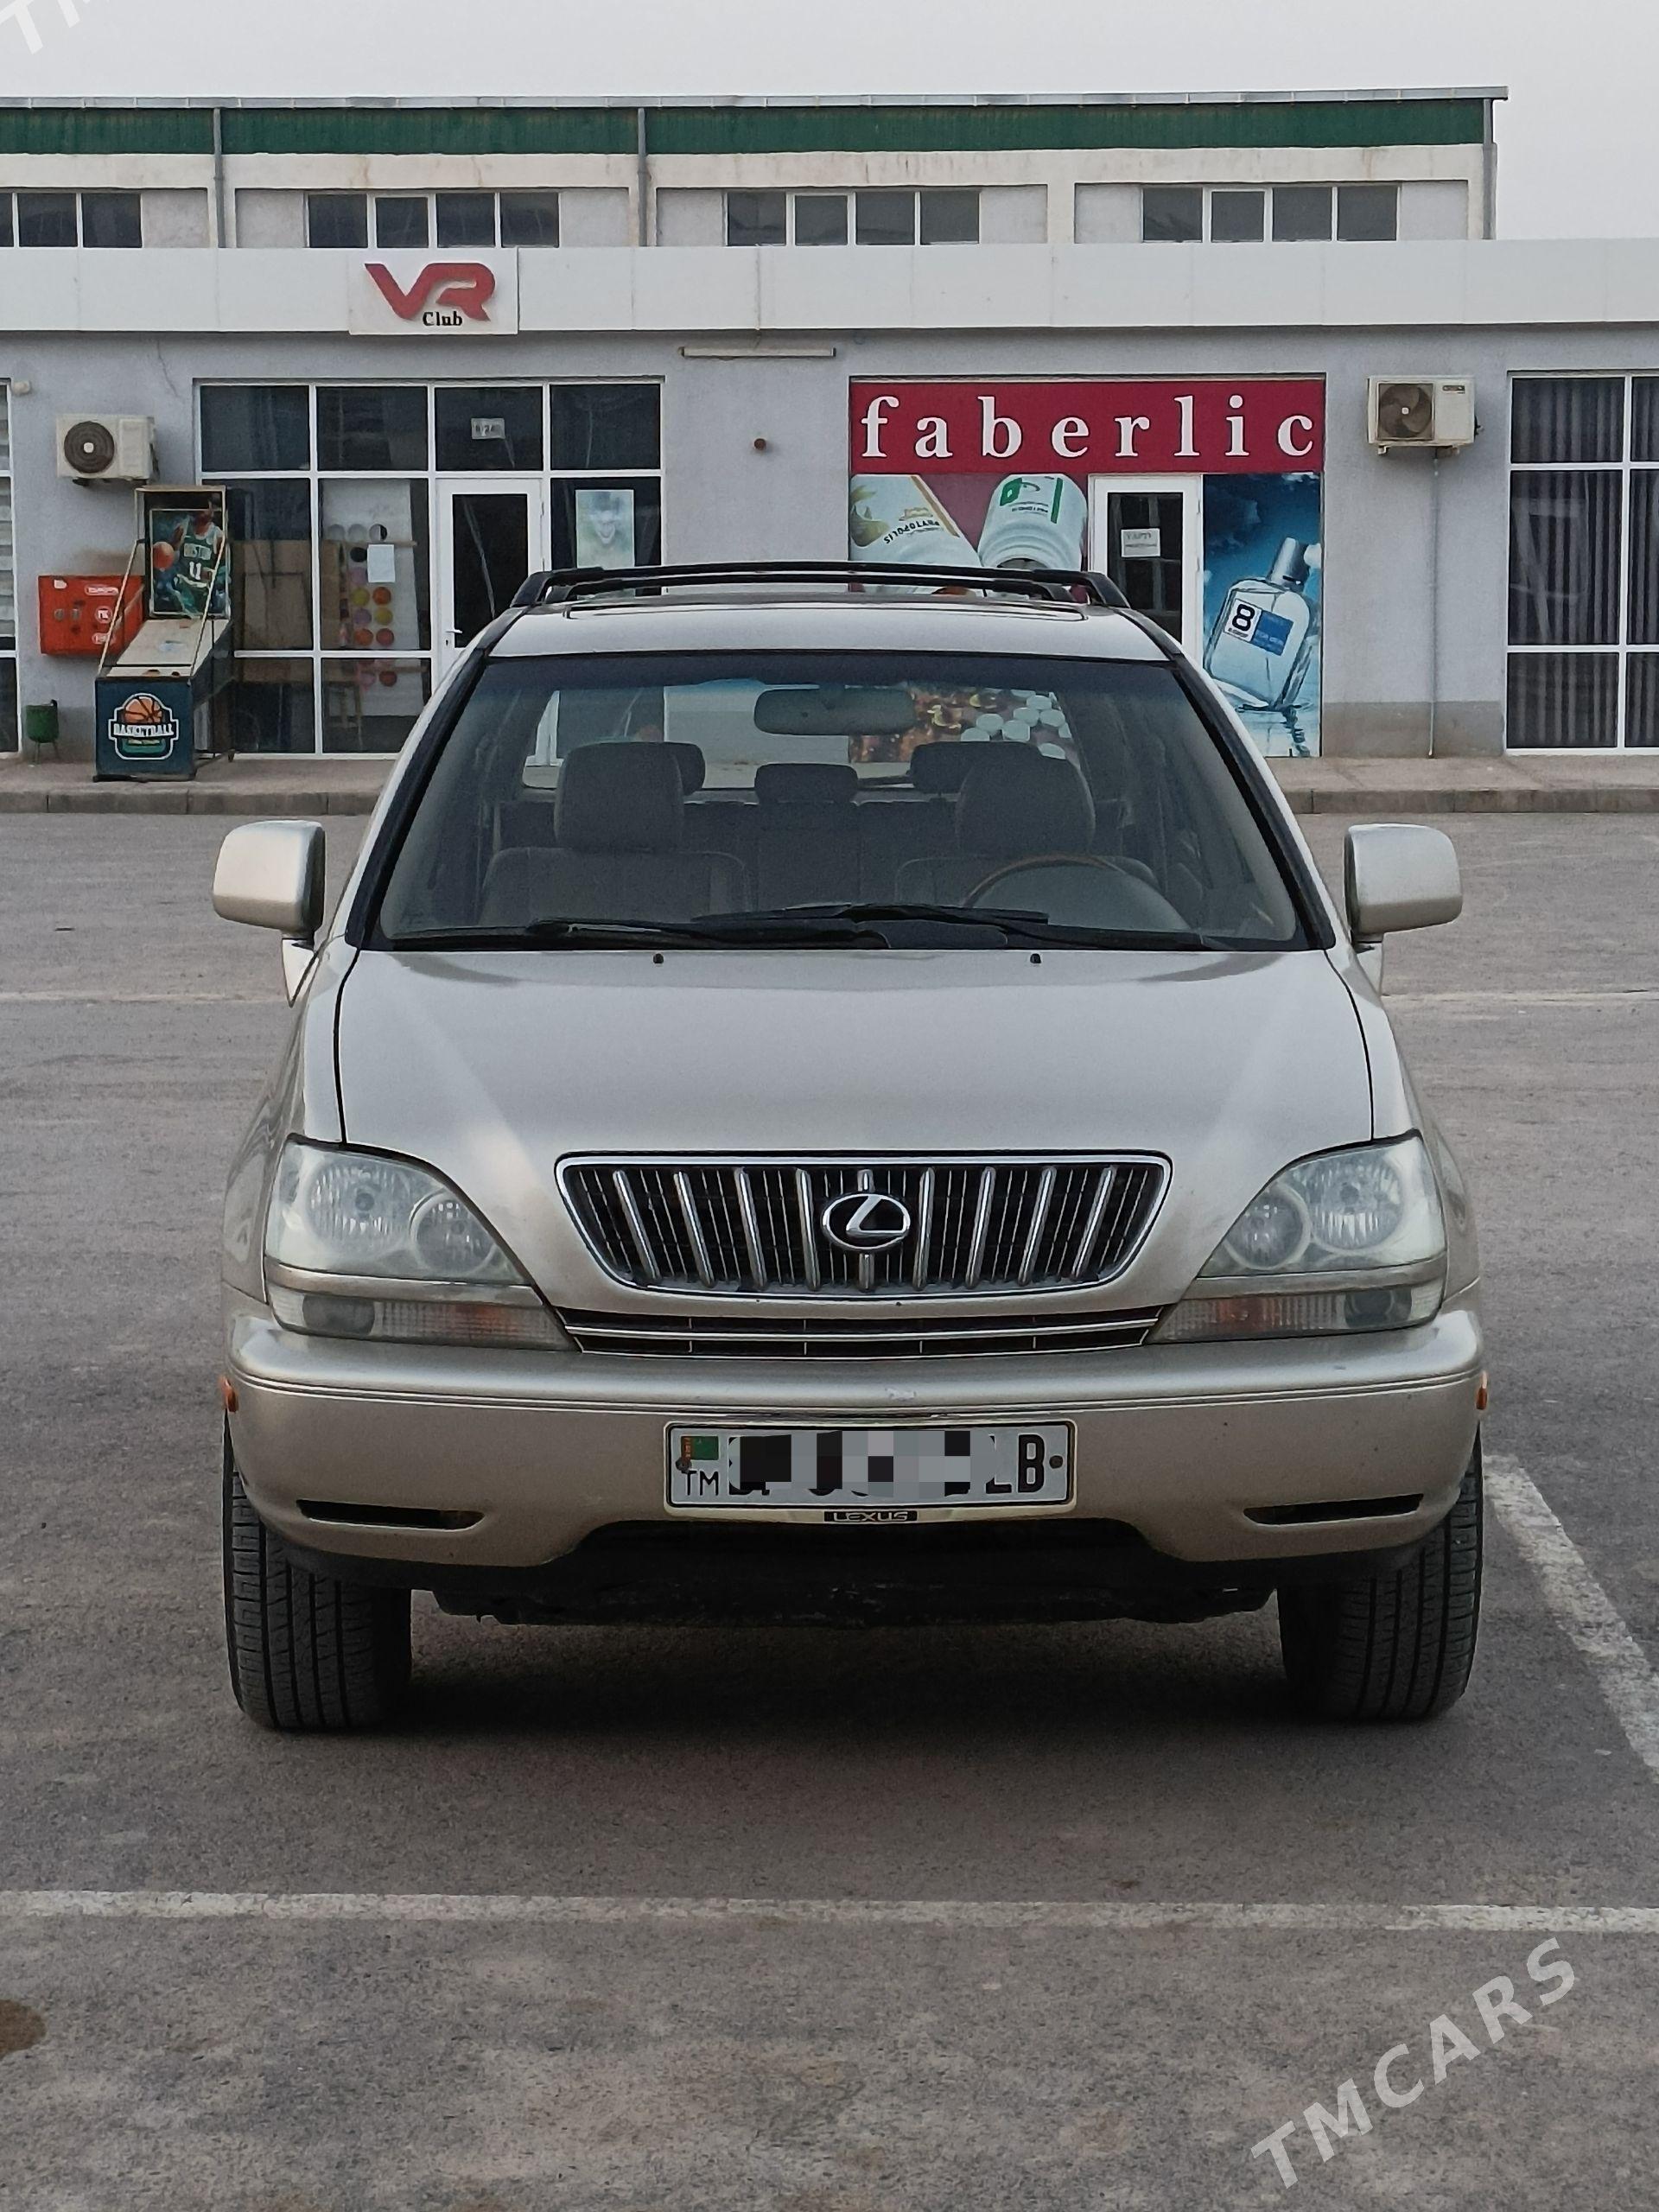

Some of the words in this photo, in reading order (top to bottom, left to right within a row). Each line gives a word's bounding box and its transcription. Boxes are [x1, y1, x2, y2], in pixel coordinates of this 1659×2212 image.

[365, 263, 495, 321] VR
[422, 311, 463, 327] Club
[861, 394, 1314, 459] faberlic
[1232, 603, 1255, 632] 8
[681, 1470, 719, 1497] TM
[833, 1511, 908, 1522] LEXUS
